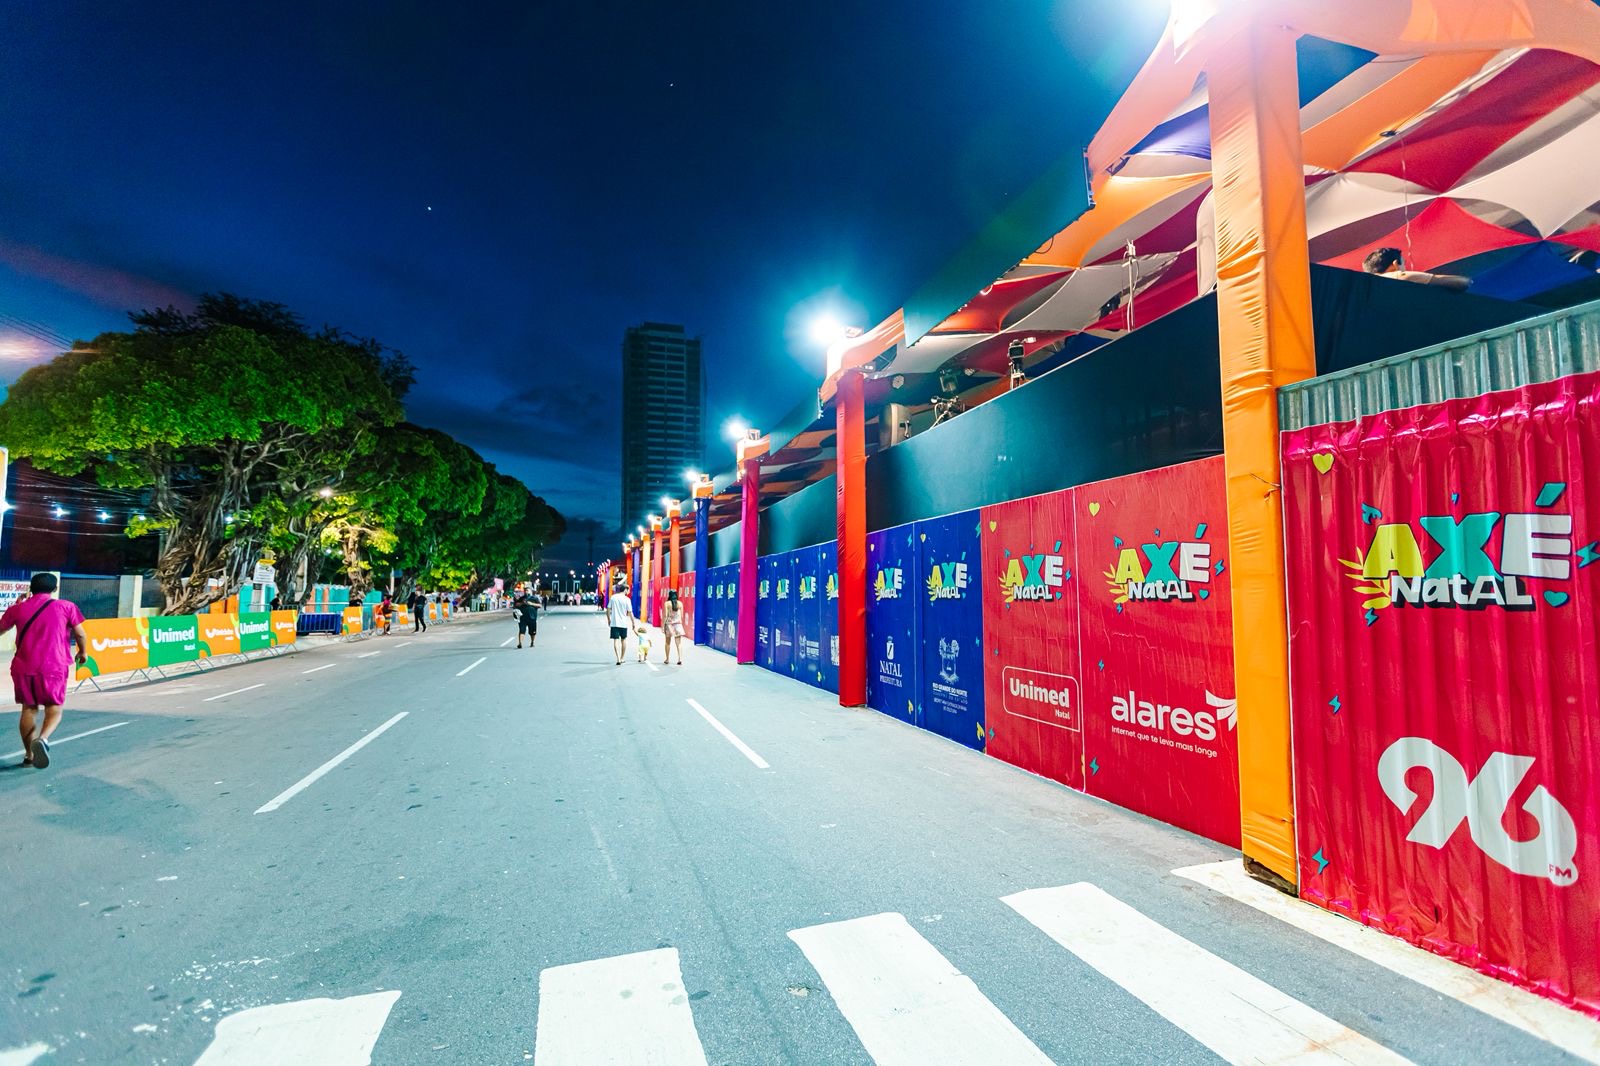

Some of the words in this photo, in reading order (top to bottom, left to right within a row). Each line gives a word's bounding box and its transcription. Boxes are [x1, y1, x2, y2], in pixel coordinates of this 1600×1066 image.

[1363, 482, 1572, 580] AXÉ
[1006, 541, 1064, 587] AXÉ
[1115, 524, 1211, 582] AXÉ
[877, 559, 903, 589] AXÉ
[931, 552, 968, 588] AXÉ
[153, 626, 196, 643] Unimed
[239, 620, 269, 635] Unimed
[880, 660, 903, 678] NATAL
[1009, 677, 1070, 708] Unimed
[1055, 709, 1071, 720] Natal
[1111, 691, 1217, 741] alares
[1111, 725, 1136, 738] Internet
[1137, 732, 1150, 741] que
[1151, 735, 1159, 743] te
[1159, 736, 1175, 747] leva
[1175, 742, 1194, 752] mais
[1194, 744, 1218, 758] longe
[1378, 737, 1577, 877] 96
[1548, 863, 1573, 879] FM
